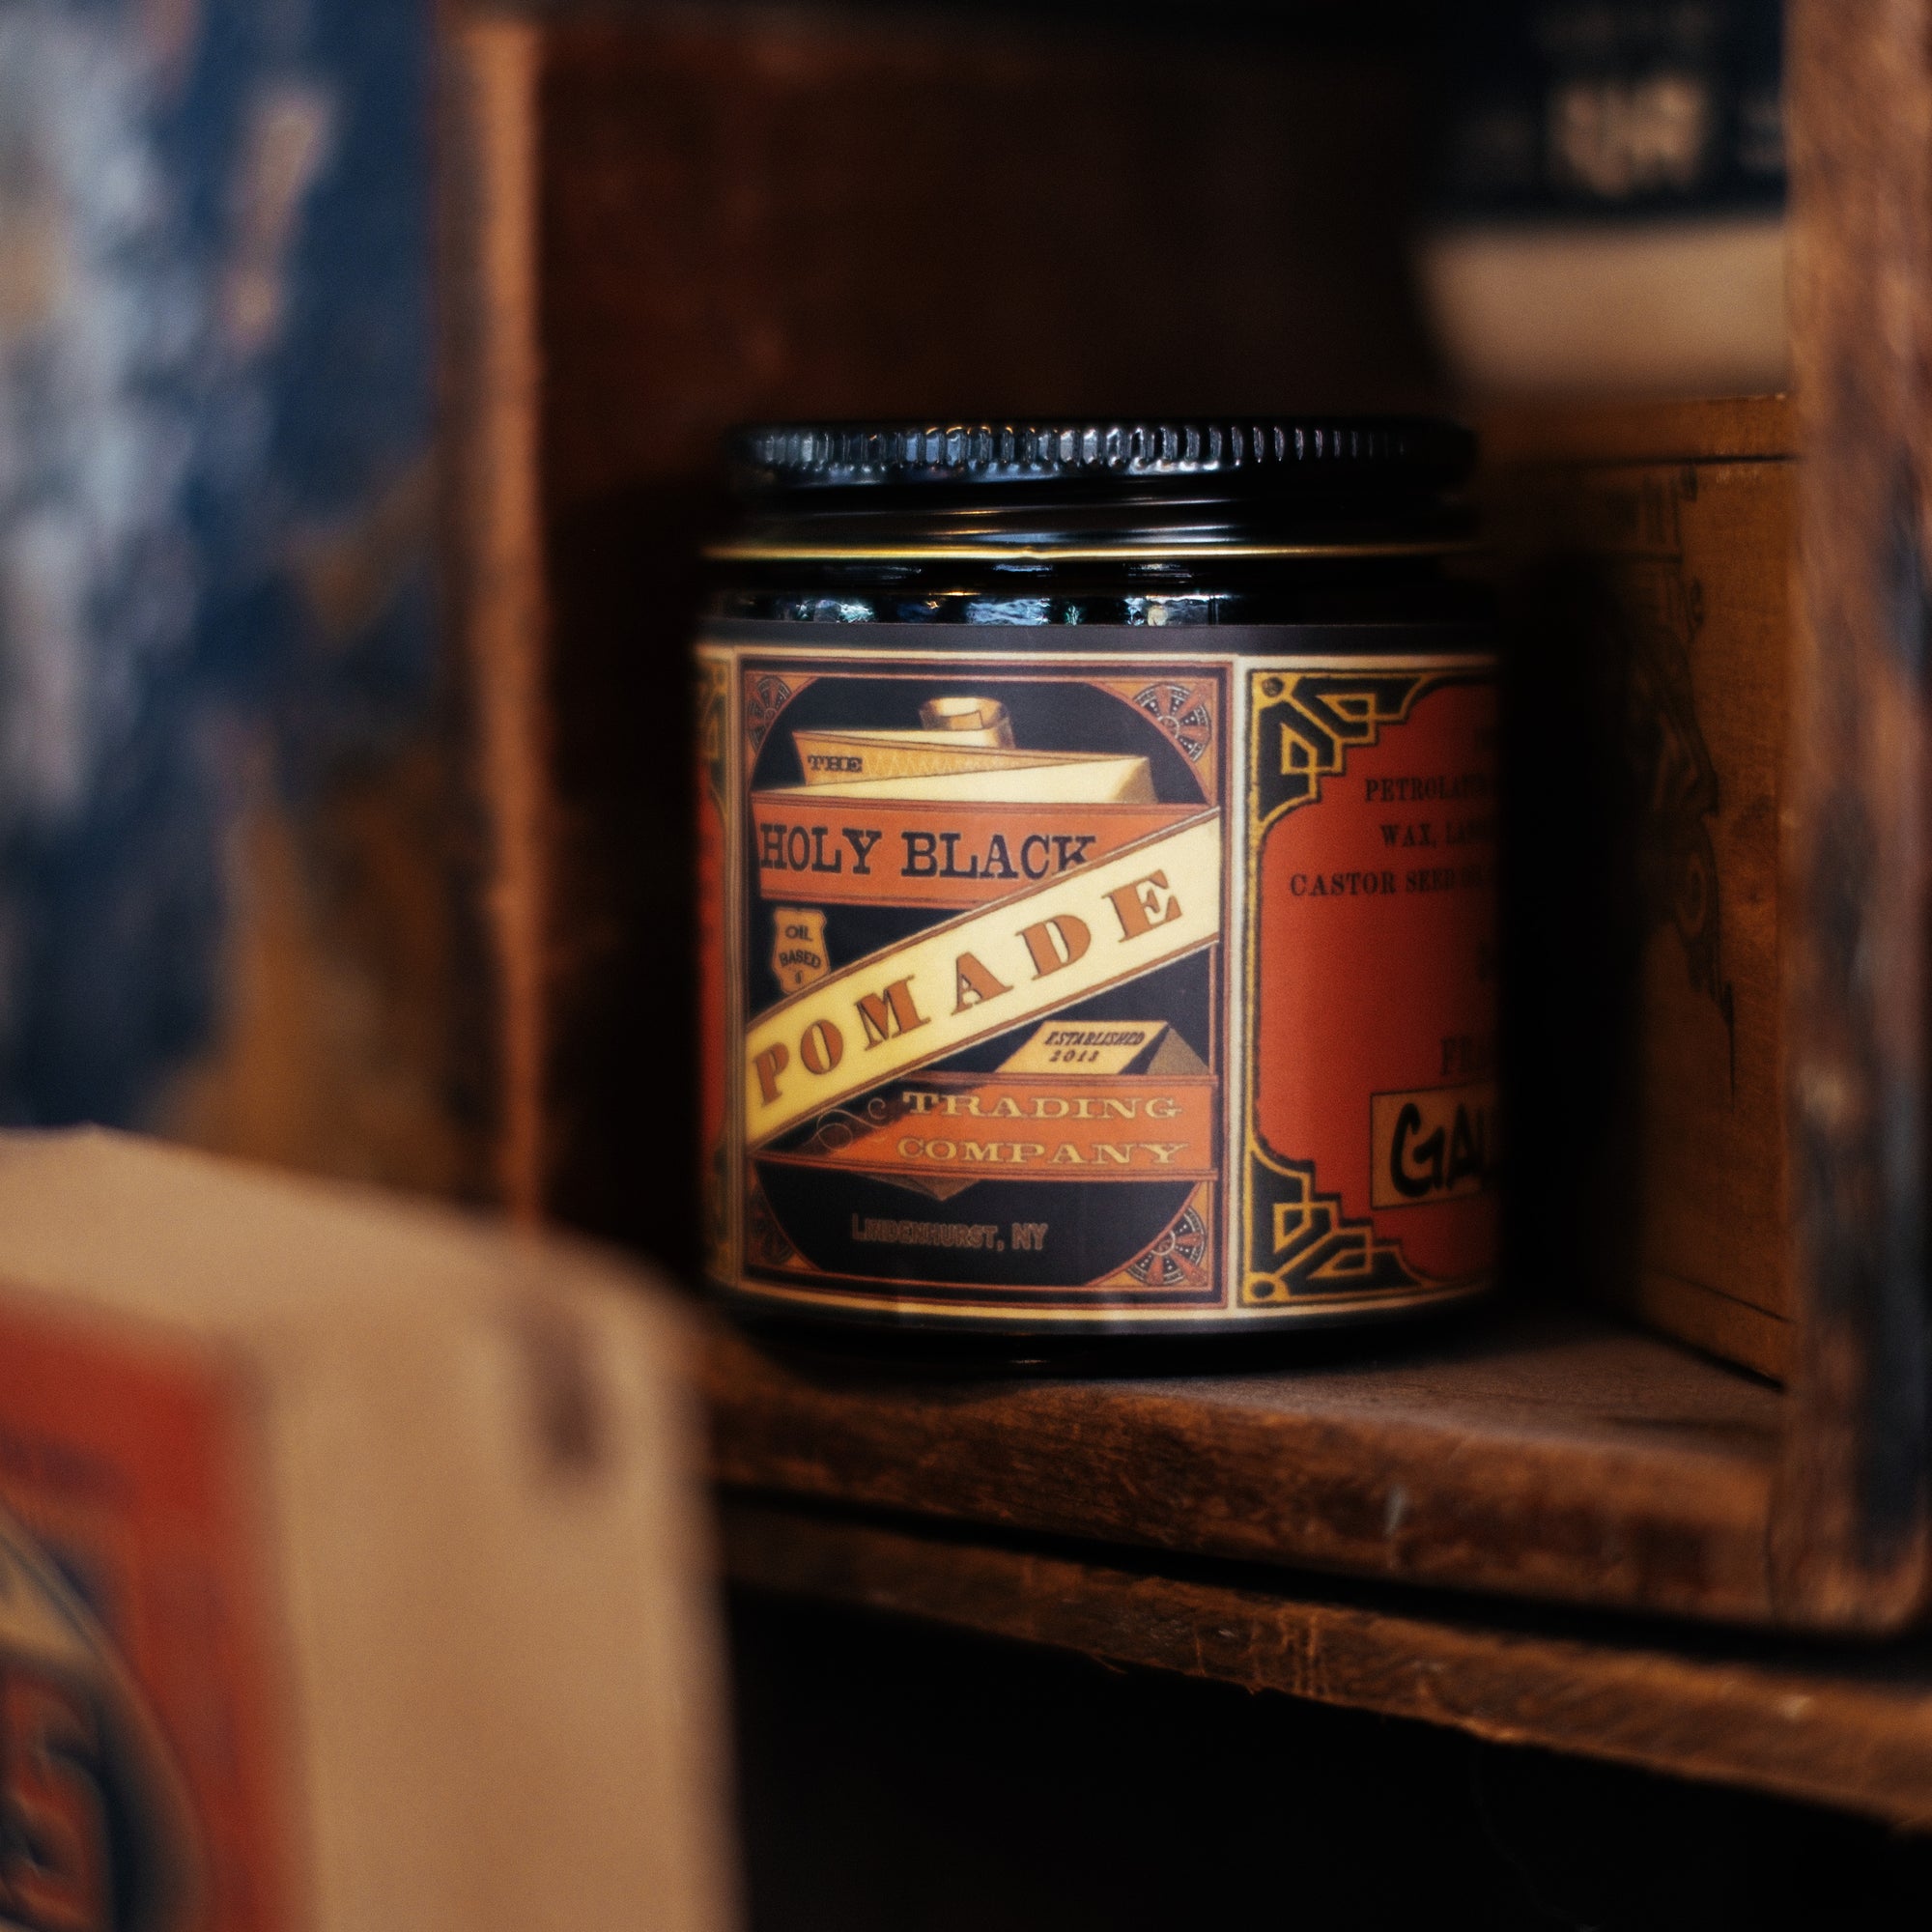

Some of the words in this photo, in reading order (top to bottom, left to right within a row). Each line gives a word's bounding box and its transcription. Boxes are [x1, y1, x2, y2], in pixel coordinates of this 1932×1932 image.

[807, 755, 863, 773] THE
[1380, 824, 1437, 849] WAX,
[759, 823, 882, 873] HOLY
[900, 831, 1096, 880] BLACK
[1290, 871, 1397, 896] CASTOR
[1405, 867, 1455, 893] SEED
[785, 924, 813, 942] OIL
[779, 949, 821, 970] BASED
[752, 868, 1182, 1109] POMADE
[1044, 1030, 1146, 1046] ESTABLISHED
[901, 1091, 1181, 1119] TRADING
[896, 1137, 1189, 1165] COMPANY
[1010, 1222, 1049, 1251] NY
